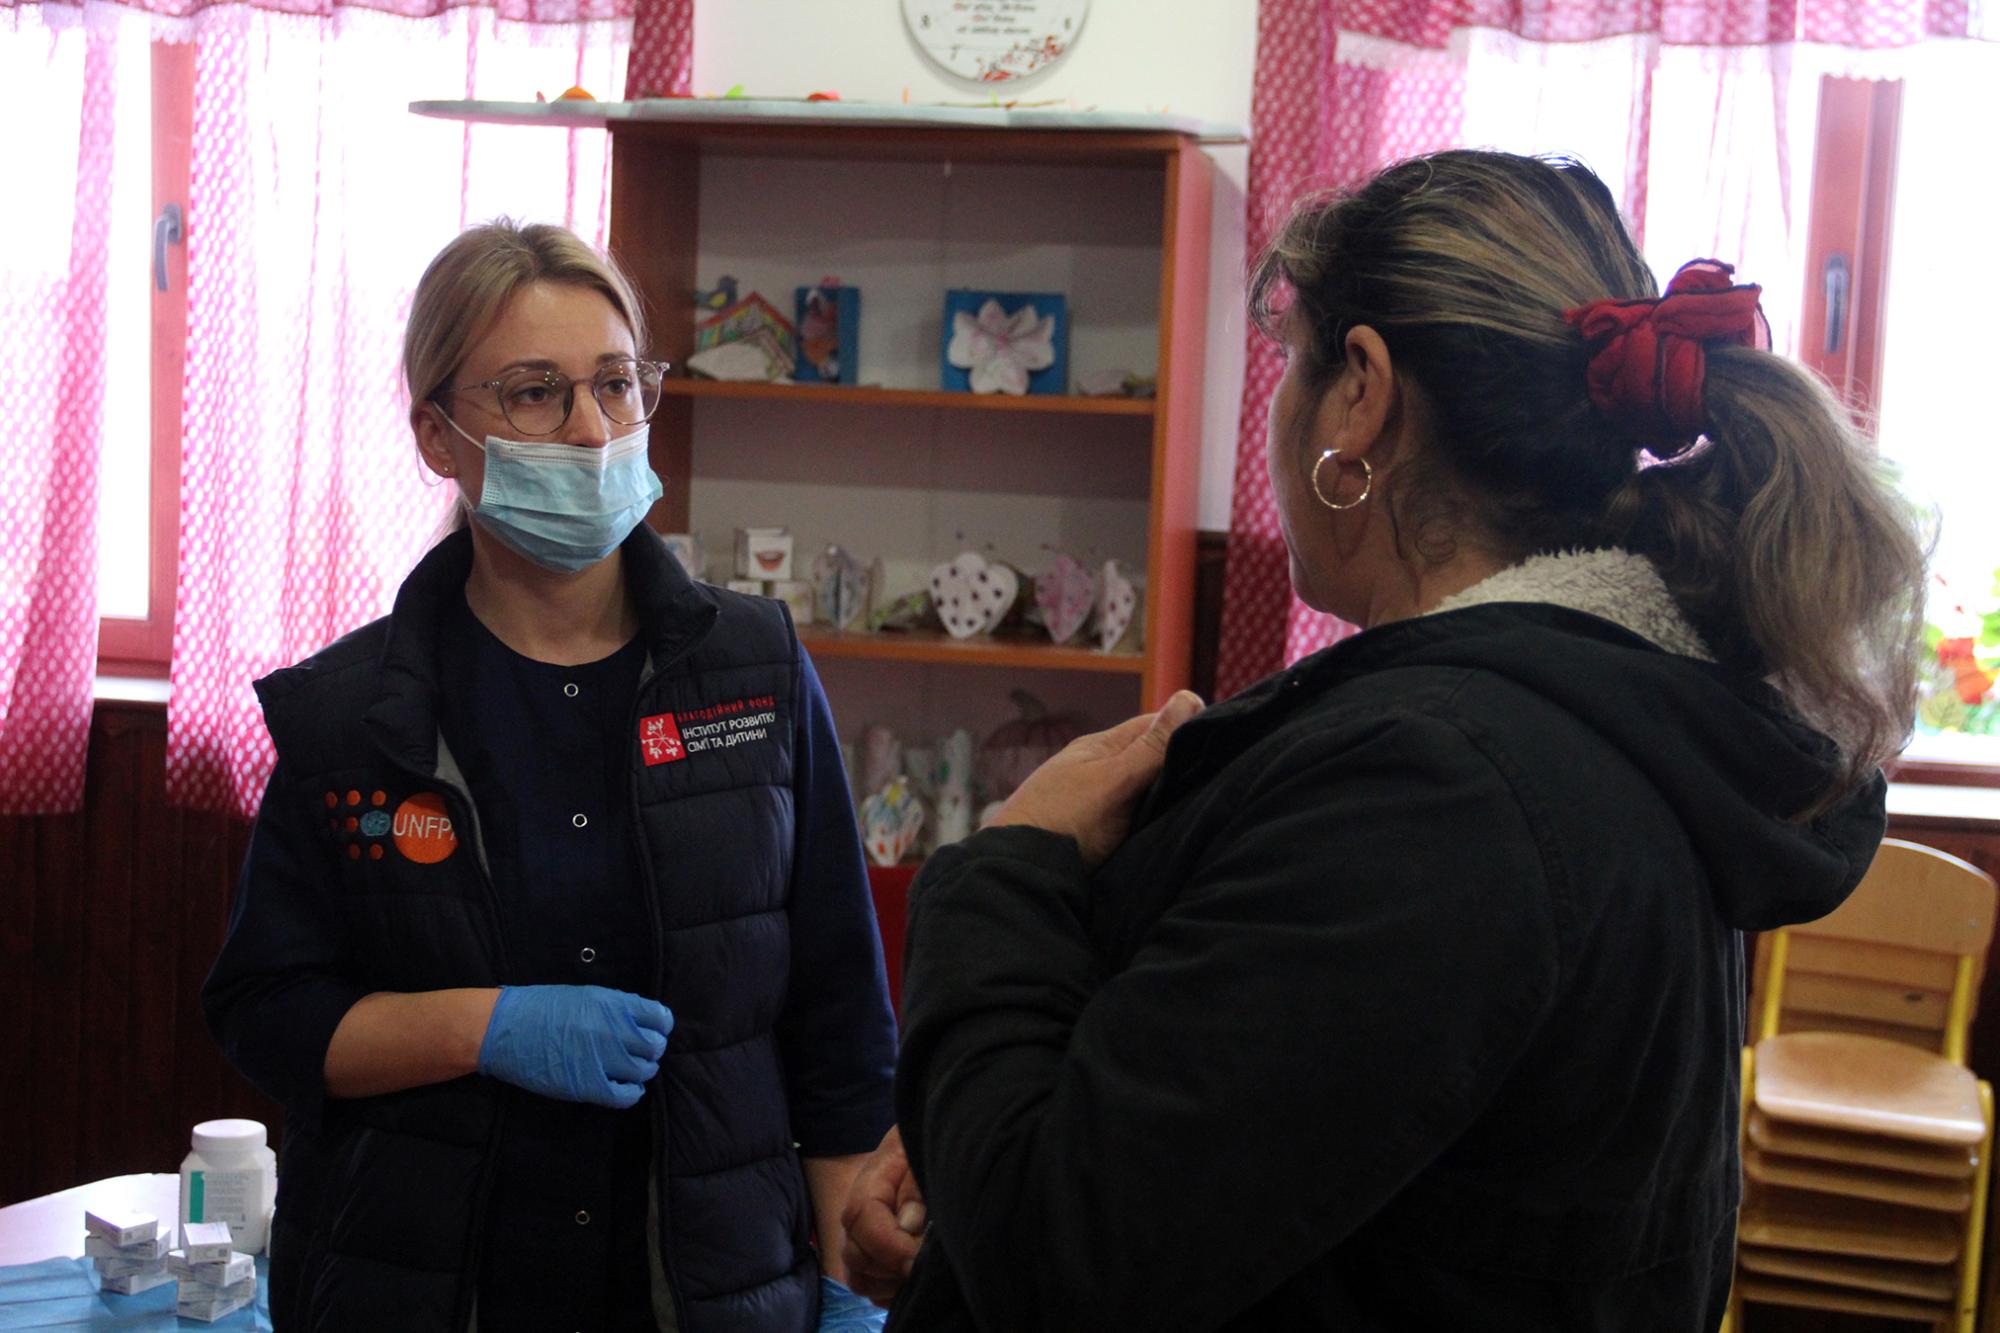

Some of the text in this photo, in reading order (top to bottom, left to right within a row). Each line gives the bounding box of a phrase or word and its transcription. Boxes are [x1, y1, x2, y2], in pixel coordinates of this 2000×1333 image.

[682, 711, 776, 740] ІНСТИТУТ РОЗВИТКУ
[710, 737, 724, 748] ТА
[725, 728, 768, 747] ДИТИНИ
